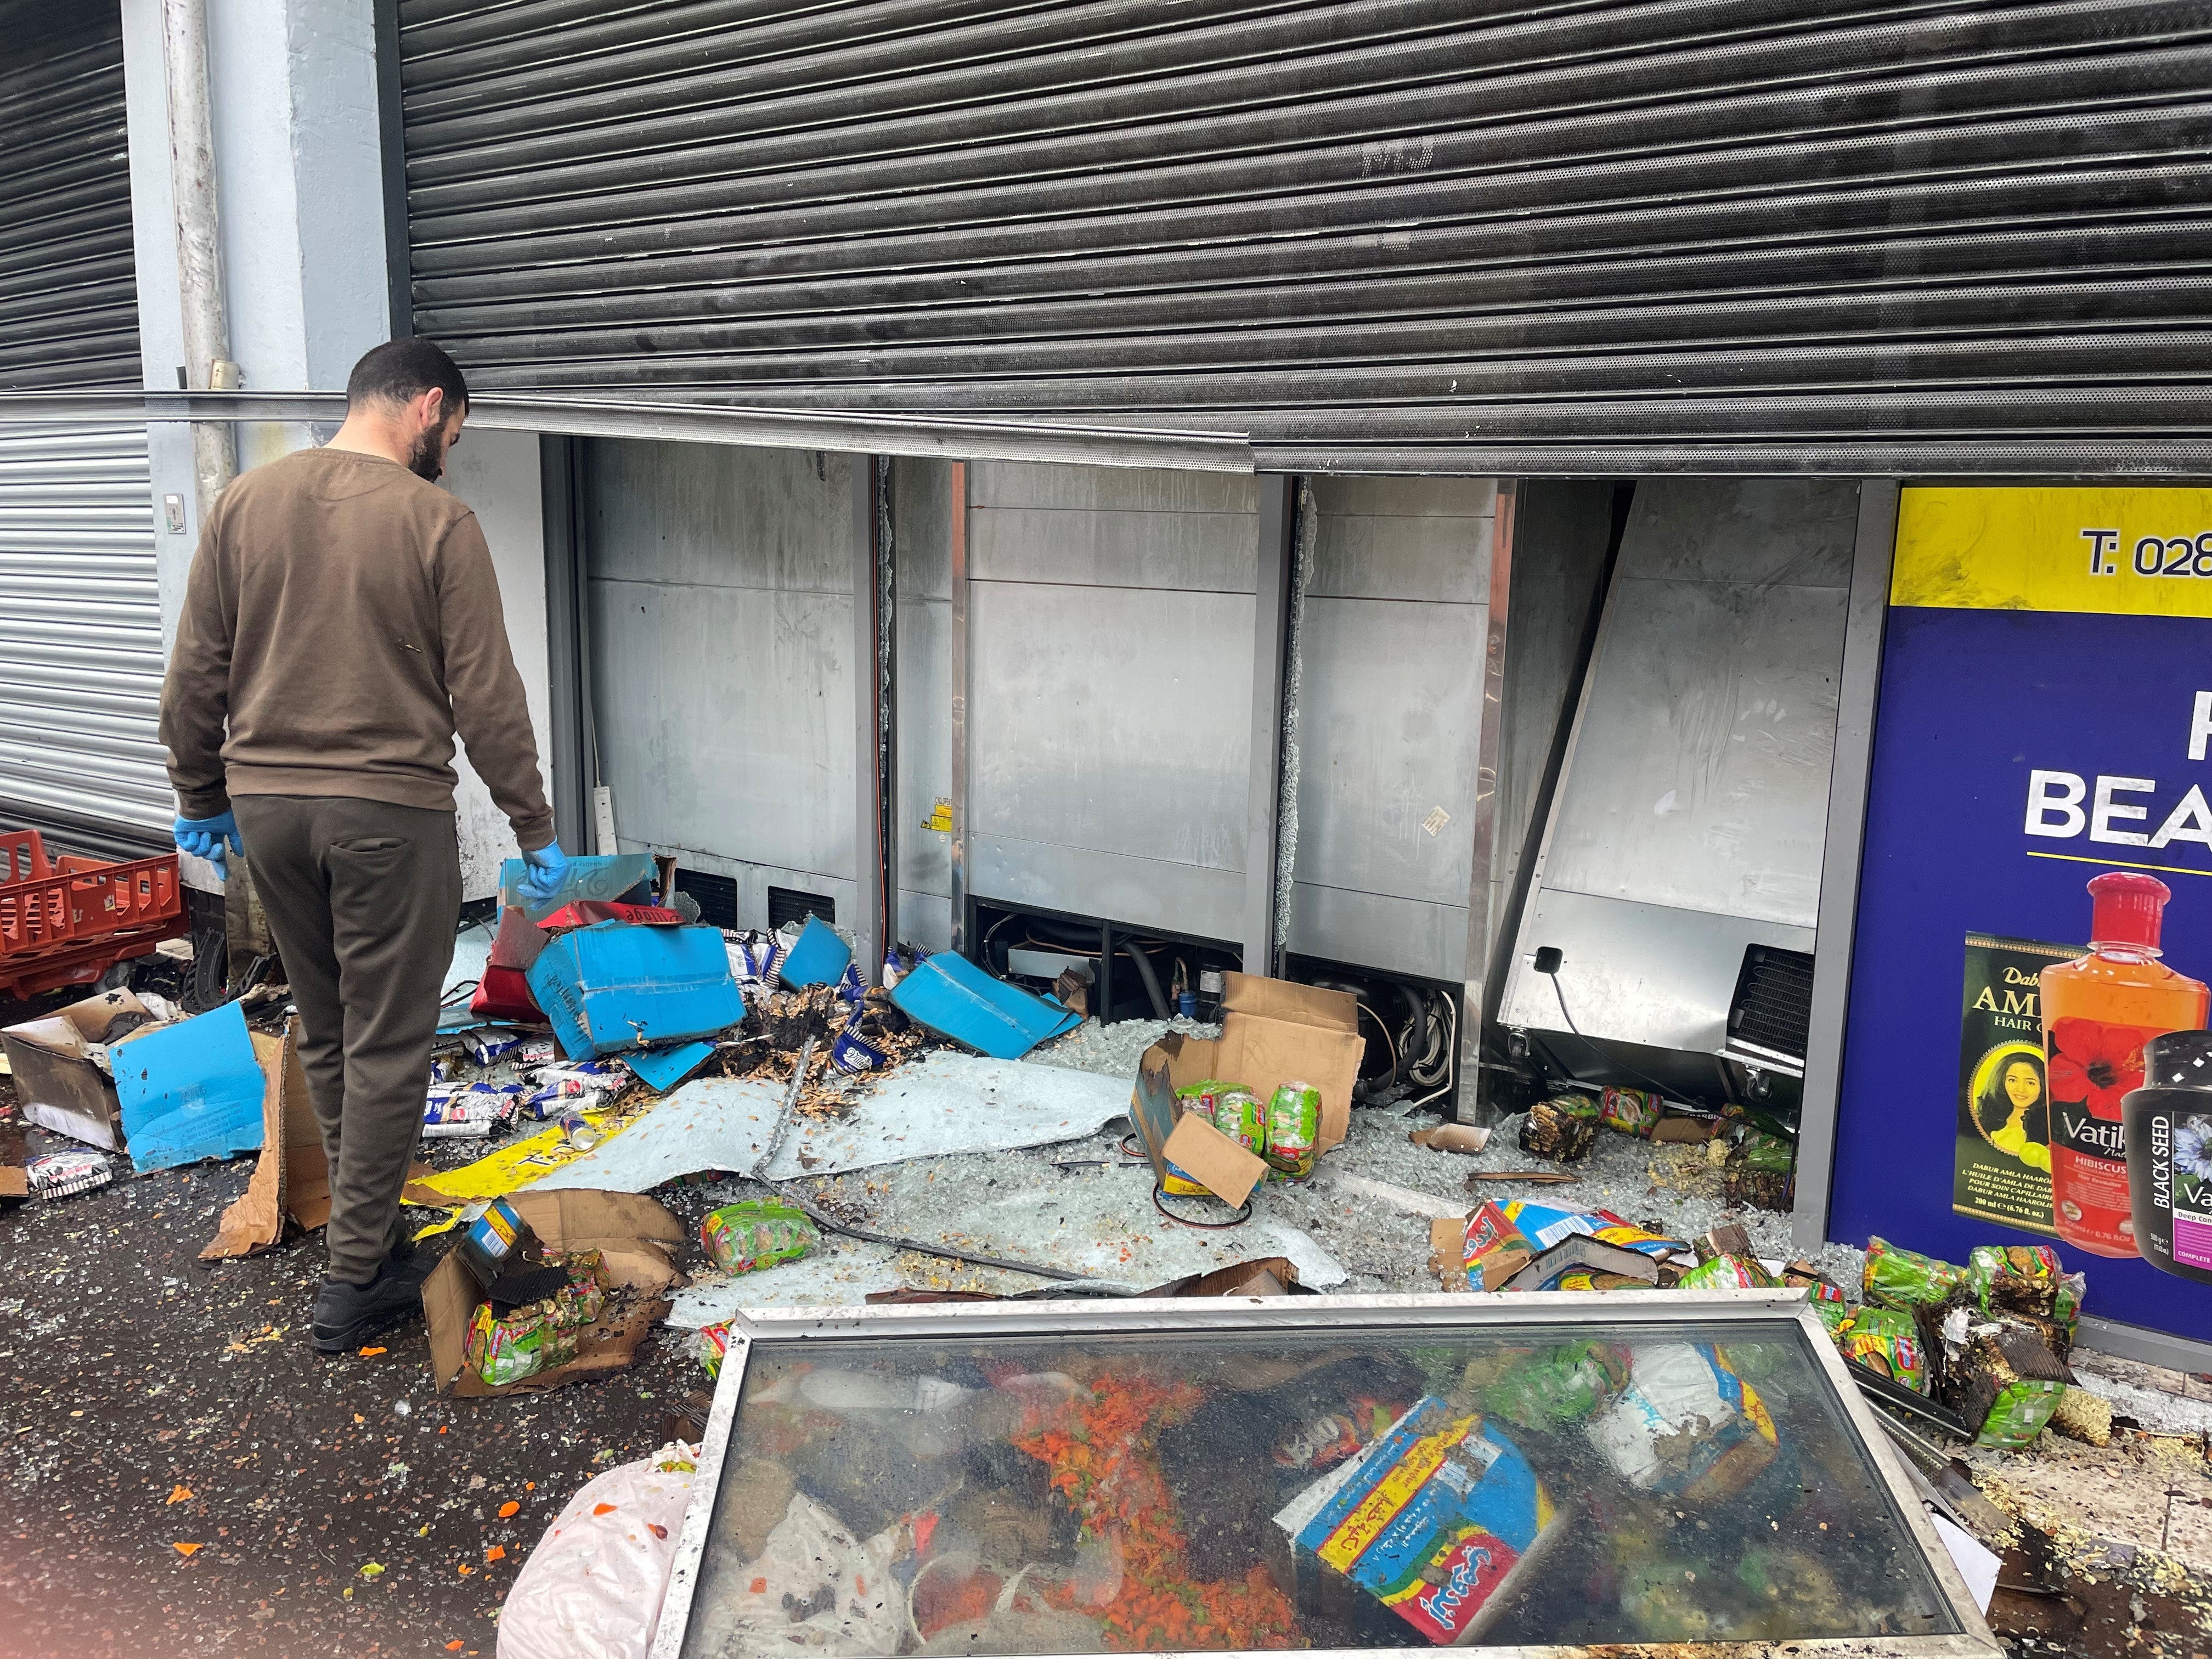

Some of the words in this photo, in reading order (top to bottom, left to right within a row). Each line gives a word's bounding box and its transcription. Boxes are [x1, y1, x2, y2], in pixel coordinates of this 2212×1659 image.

[2002, 967, 2040, 988] Dab
[1994, 1015, 2032, 1031] HAIR
[2152, 1115, 2170, 1157] SEED
[1973, 1163, 1999, 1173] DABUR
[2000, 1169, 2021, 1178] AMLA
[2075, 1155, 2126, 1174] HIBISCUS
[1968, 1178, 1990, 1187] POUR
[2153, 1159, 2170, 1209] BLACK
[1967, 1186, 1994, 1195] DABUR
[1994, 1192, 2015, 1201] AMLA
[1974, 1197, 1987, 1205] 200
[2178, 1211, 2196, 1221] Deep
[2177, 1250, 2210, 1263] COMPLETE
